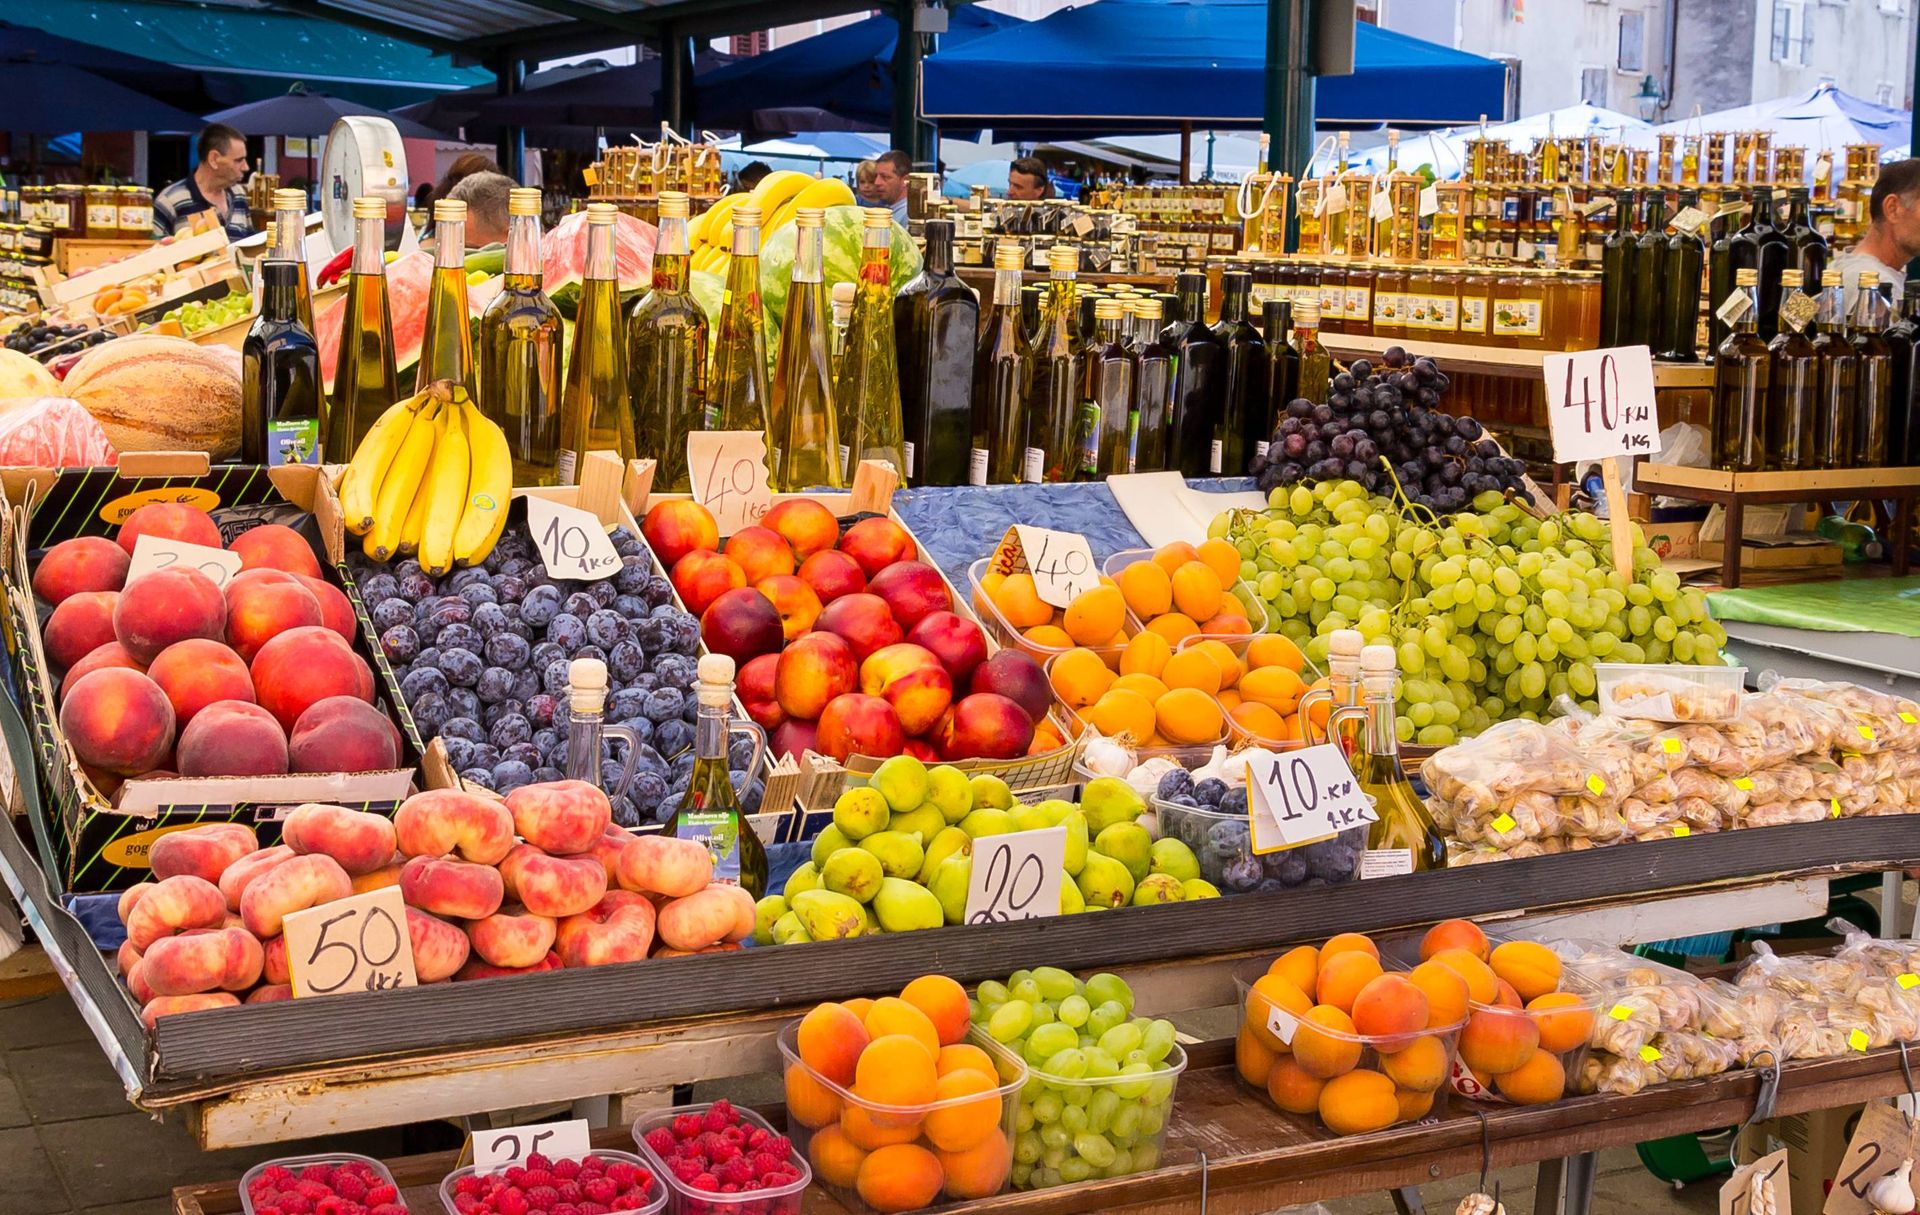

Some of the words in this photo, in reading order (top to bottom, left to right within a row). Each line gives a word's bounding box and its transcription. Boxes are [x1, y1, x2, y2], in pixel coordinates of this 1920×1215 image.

[1563, 354, 1618, 433] 40
[704, 444, 756, 515] 40
[542, 516, 590, 567] 10
[1035, 534, 1088, 586] 40
[1268, 757, 1319, 822] 10
[969, 843, 1044, 924] 20
[307, 906, 401, 994] 50
